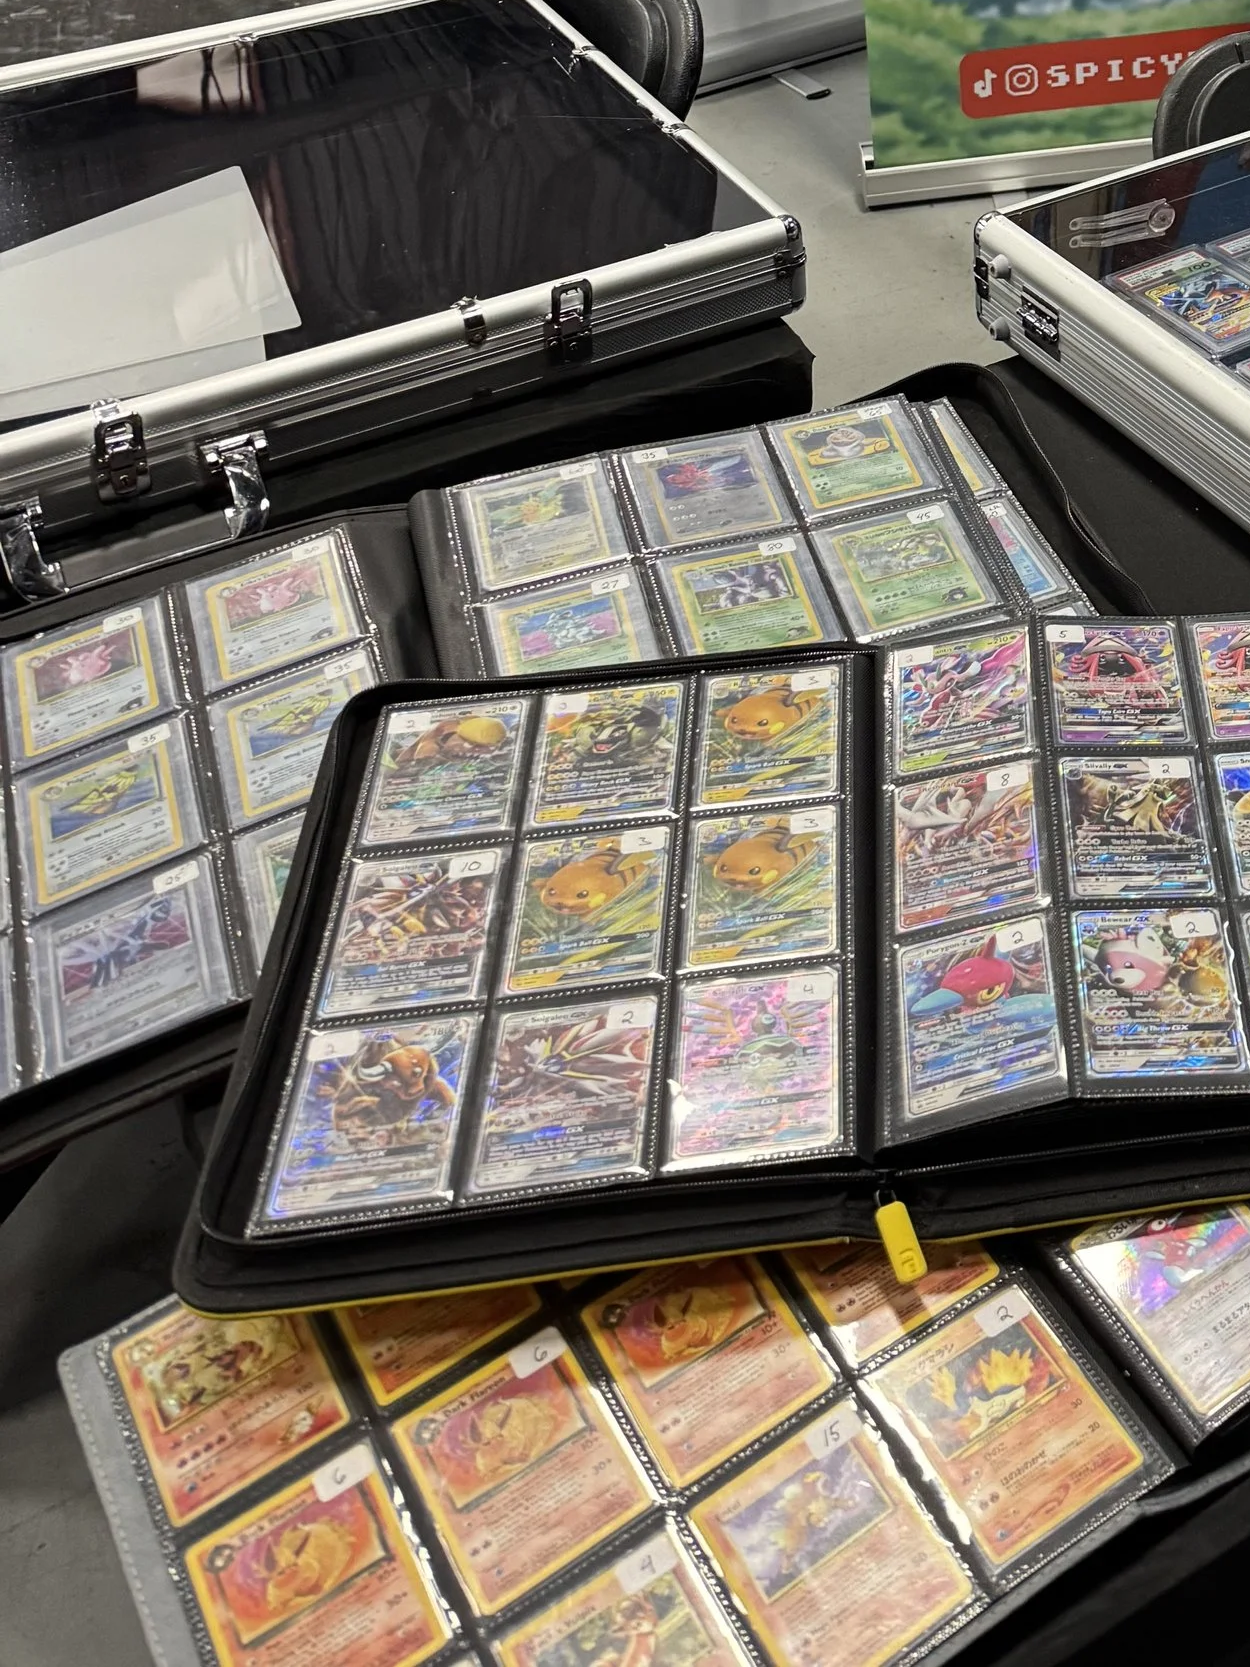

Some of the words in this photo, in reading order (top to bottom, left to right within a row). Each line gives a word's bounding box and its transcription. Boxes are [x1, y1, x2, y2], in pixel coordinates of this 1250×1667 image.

[1187, 260, 1212, 273] 100
[916, 511, 932, 521] 45
[601, 579, 619, 590] 27
[333, 661, 350, 673] 35
[807, 675, 819, 687] 3
[1126, 707, 1141, 715] GX
[977, 719, 993, 729] GX
[140, 733, 157, 745] 35
[1161, 763, 1171, 775] 2
[1000, 773, 1011, 787] 8
[803, 818, 818, 830] 3
[639, 836, 652, 847] 3
[1131, 853, 1148, 862] GX
[462, 860, 481, 873] 10
[973, 867, 989, 877] GX
[1101, 915, 1133, 924] Bewear
[1185, 921, 1200, 934] 2
[592, 936, 610, 946] GX
[1011, 931, 1024, 945] 2
[623, 1012, 635, 1025] 2
[1171, 1023, 1189, 1031] GX
[998, 1038, 1016, 1048] GX
[996, 1304, 1014, 1322] 2
[533, 1346, 548, 1362] 6
[1071, 1396, 1084, 1410] 30
[1087, 1421, 1101, 1434] 20
[822, 1420, 841, 1448] 15
